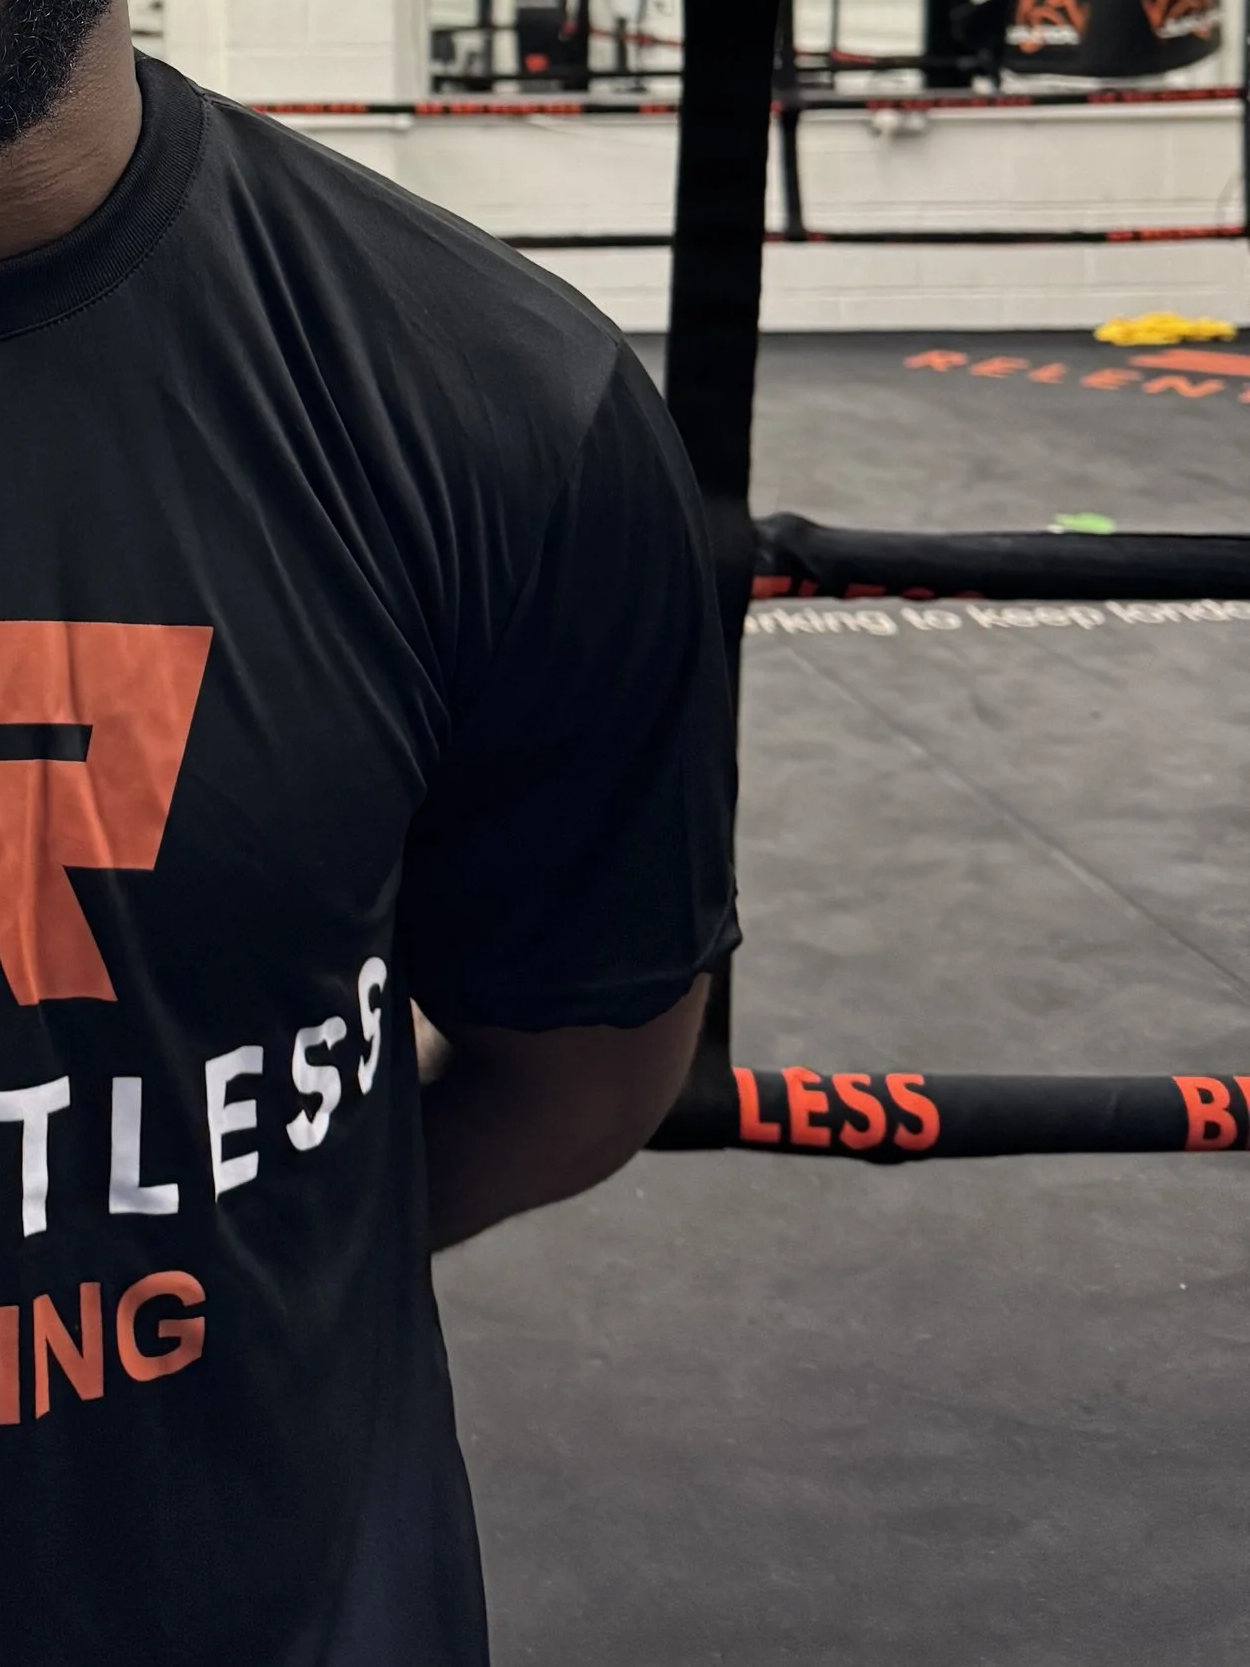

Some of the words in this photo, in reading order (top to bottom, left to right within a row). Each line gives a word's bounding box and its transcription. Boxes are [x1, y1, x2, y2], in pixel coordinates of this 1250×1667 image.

[903, 349, 1250, 404] RELEN
[900, 605, 963, 631] to
[965, 602, 1106, 630] keep
